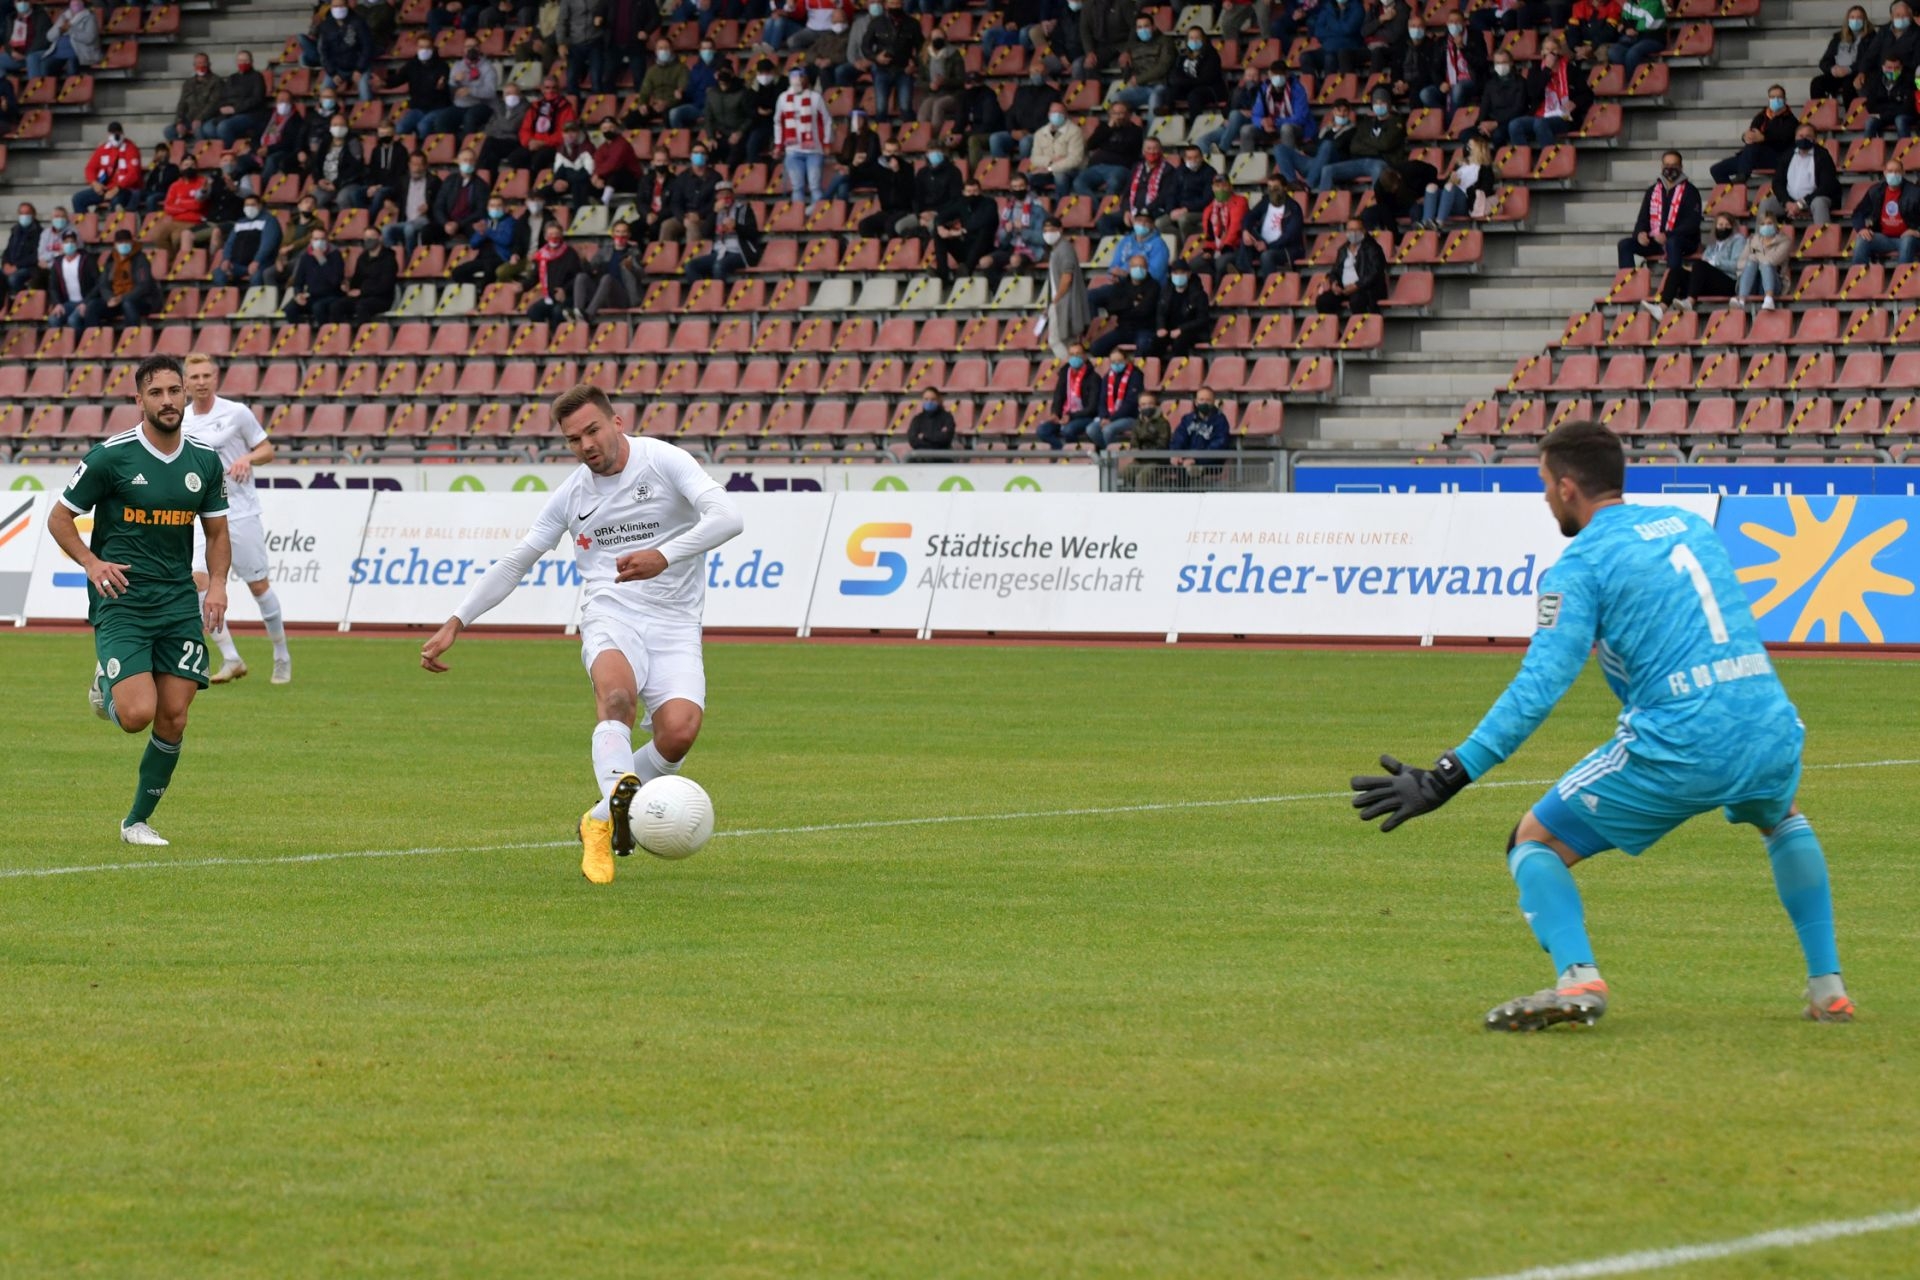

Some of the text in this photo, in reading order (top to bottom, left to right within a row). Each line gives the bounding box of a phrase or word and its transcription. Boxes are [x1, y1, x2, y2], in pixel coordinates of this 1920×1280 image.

[264, 529, 316, 552] erke
[594, 521, 660, 537] DRK-Kliniken
[597, 532, 654, 546] Nordhessen
[1186, 531, 1414, 545] JETZT AM BALL BLEIBEN UNTER:
[925, 534, 1138, 560] Städtische Werke
[917, 566, 1145, 598] Aktiengesellschaft
[1668, 543, 1730, 645] 1
[177, 641, 204, 675] 22
